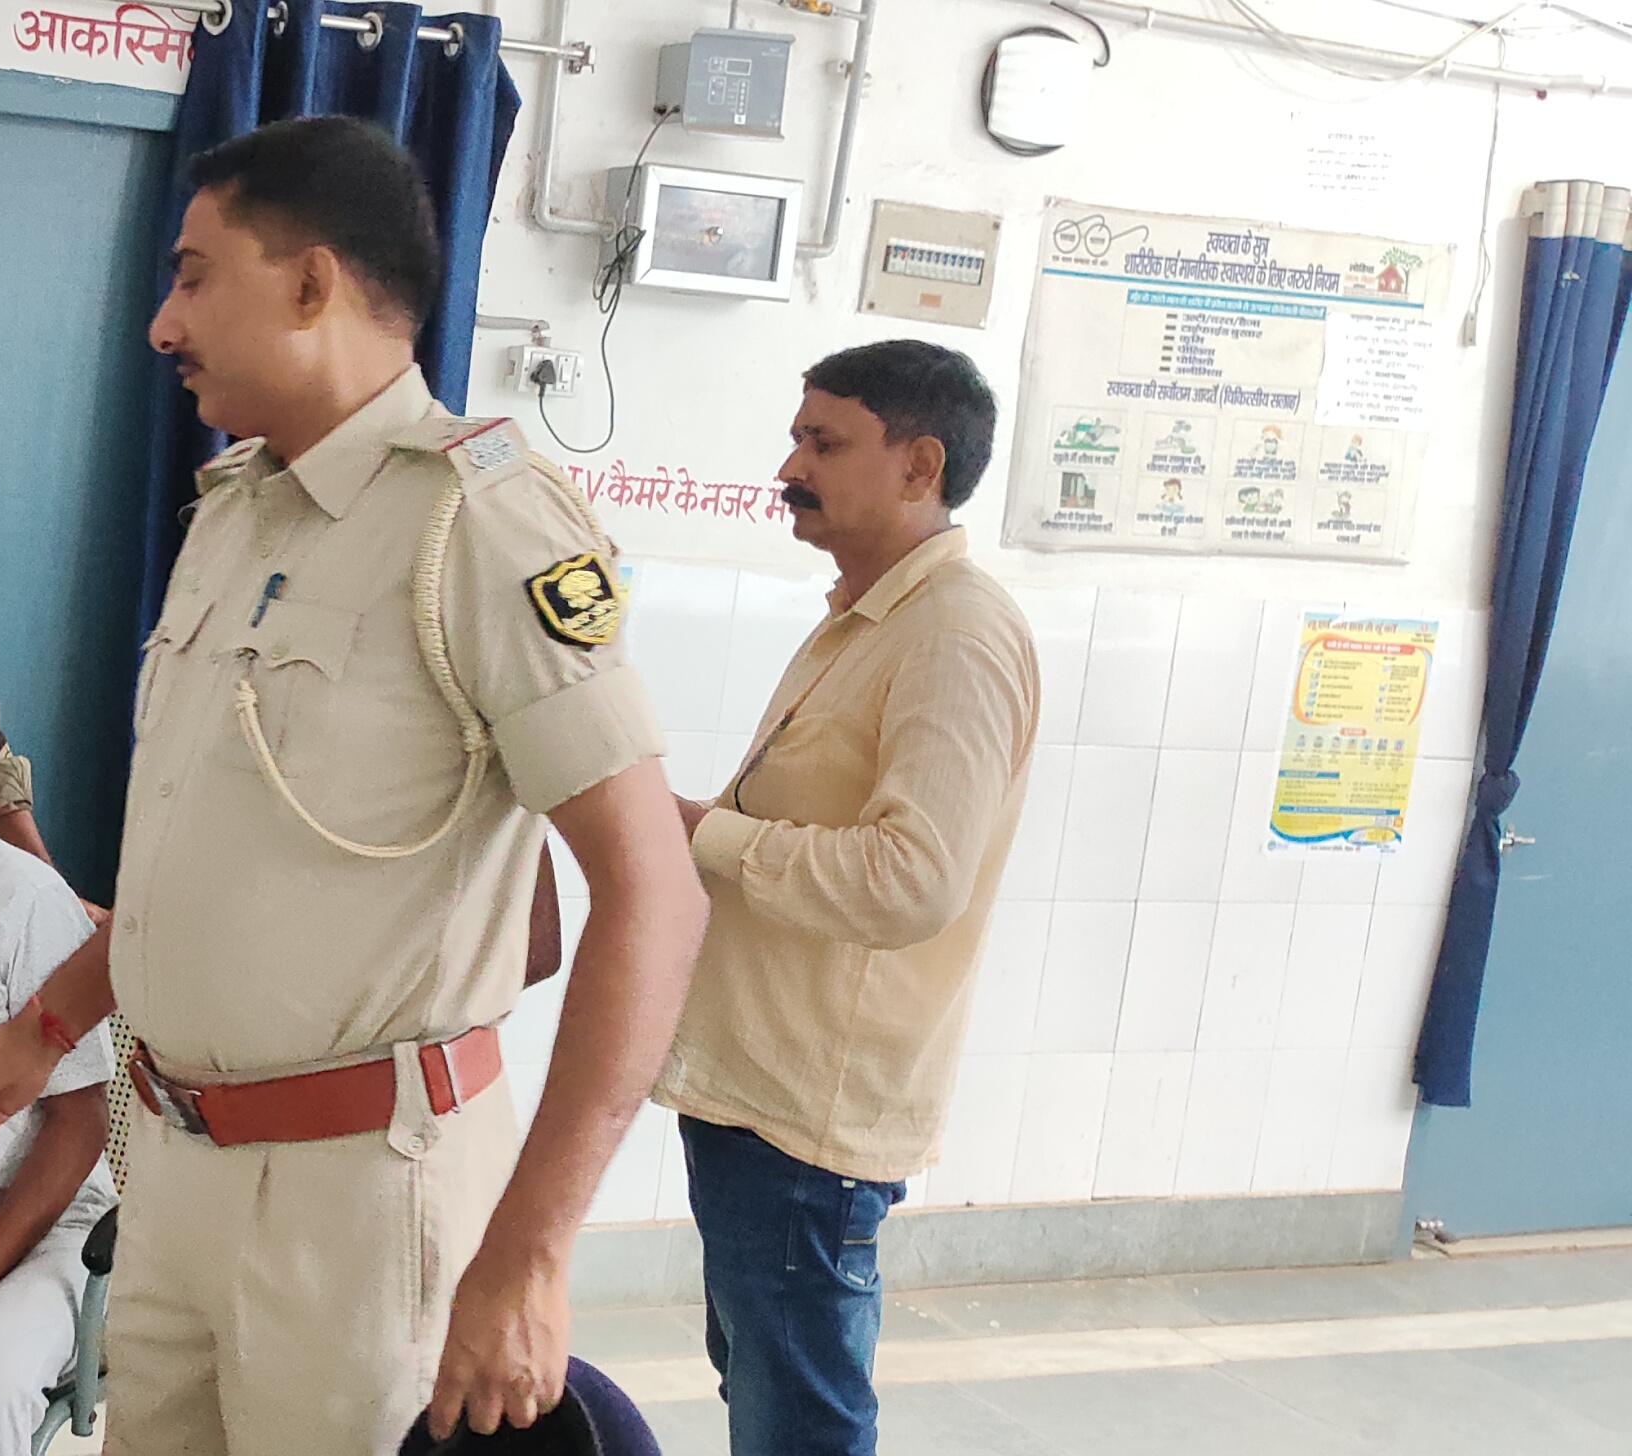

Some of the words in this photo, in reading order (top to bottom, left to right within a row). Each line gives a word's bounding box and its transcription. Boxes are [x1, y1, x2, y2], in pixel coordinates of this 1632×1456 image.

[14, 4, 194, 72] आकस्मि
[1206, 229, 1241, 255] स्वच्छता
[1241, 229, 1252, 256] के
[1164, 248, 1180, 279] एवं
[1178, 253, 1220, 281] मानसिक
[1256, 260, 1267, 286] के
[1267, 259, 1287, 290] लिए
[1314, 264, 1341, 293] नियम
[1106, 379, 1143, 400] स्वच्छता
[1143, 379, 1157, 400] की
[1270, 388, 1302, 415] सलाह)
[607, 459, 675, 513] कैमरे
[674, 467, 698, 516] के
[700, 481, 763, 524] नजर
